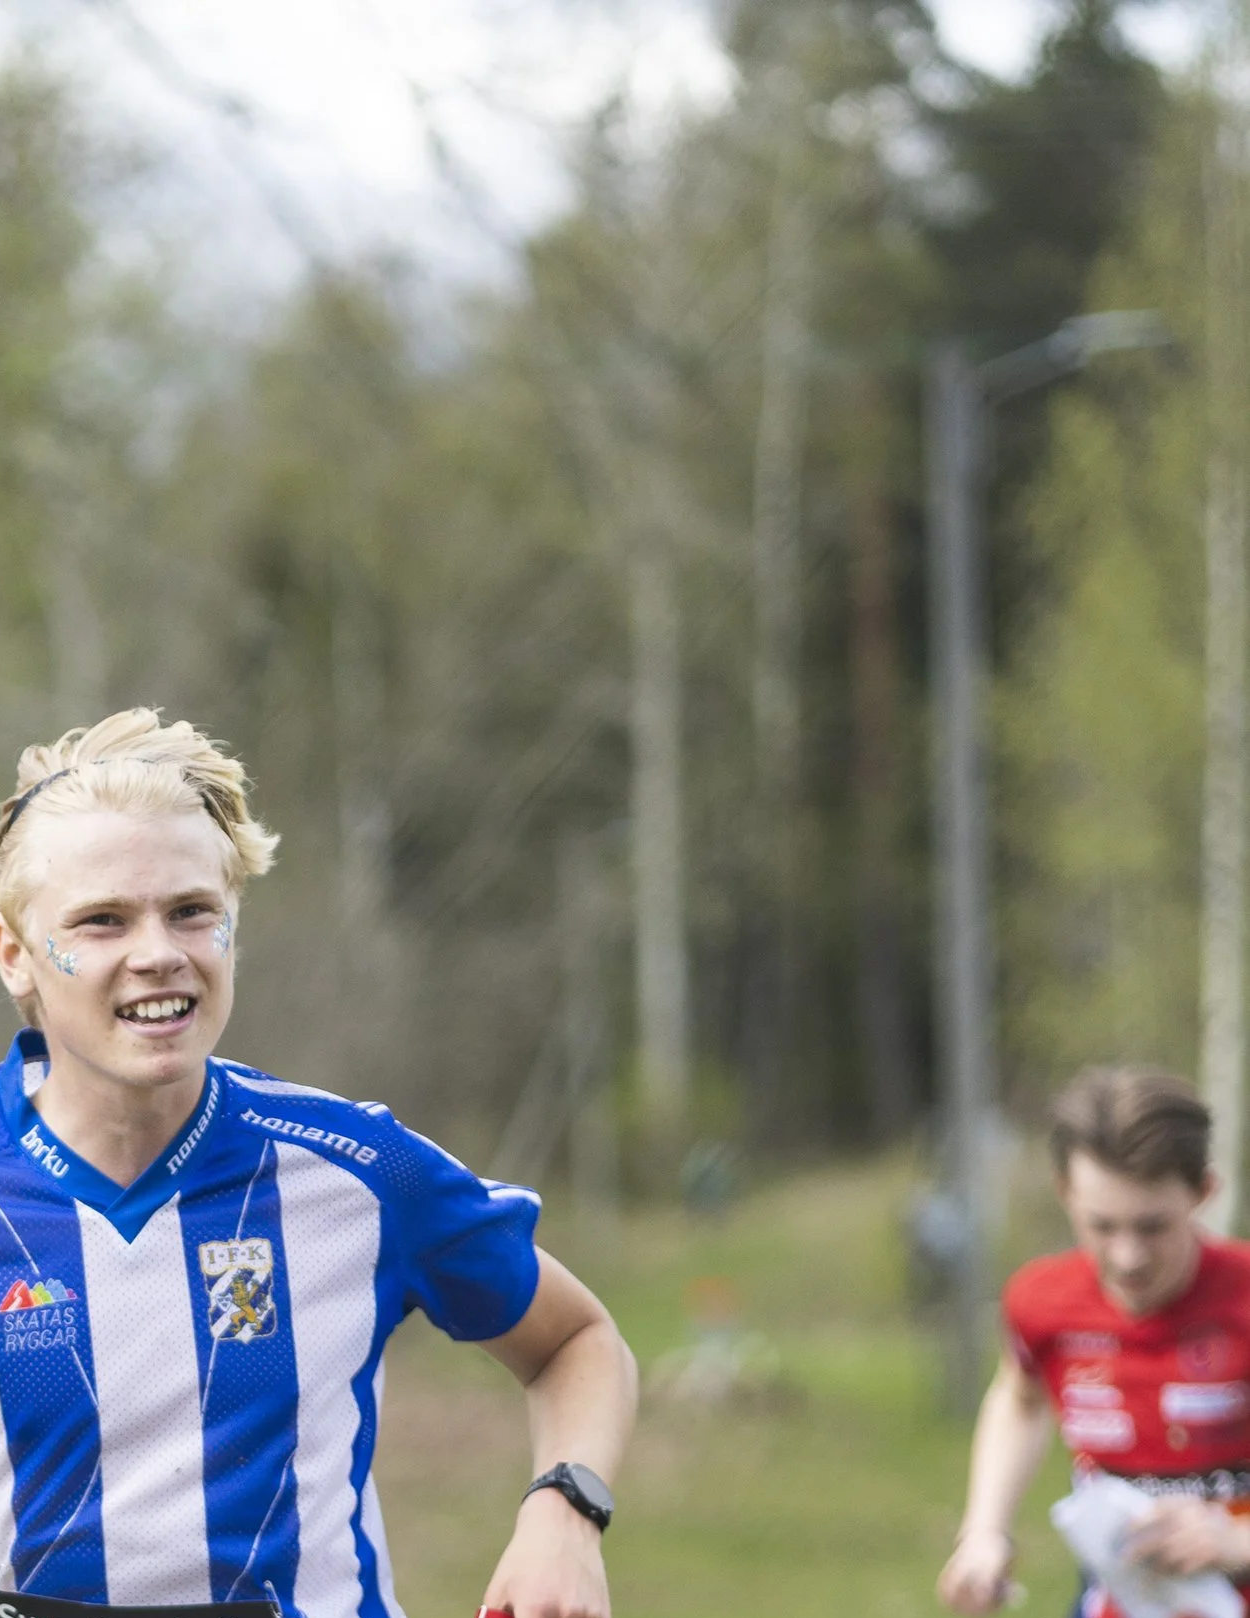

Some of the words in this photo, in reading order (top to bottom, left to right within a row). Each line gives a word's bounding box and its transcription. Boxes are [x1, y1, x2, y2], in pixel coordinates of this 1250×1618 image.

[166, 1077, 221, 1175] noname
[240, 1107, 378, 1166] noname
[3, 1306, 75, 1332] SKATAS
[5, 1326, 77, 1352] RYGGAR
